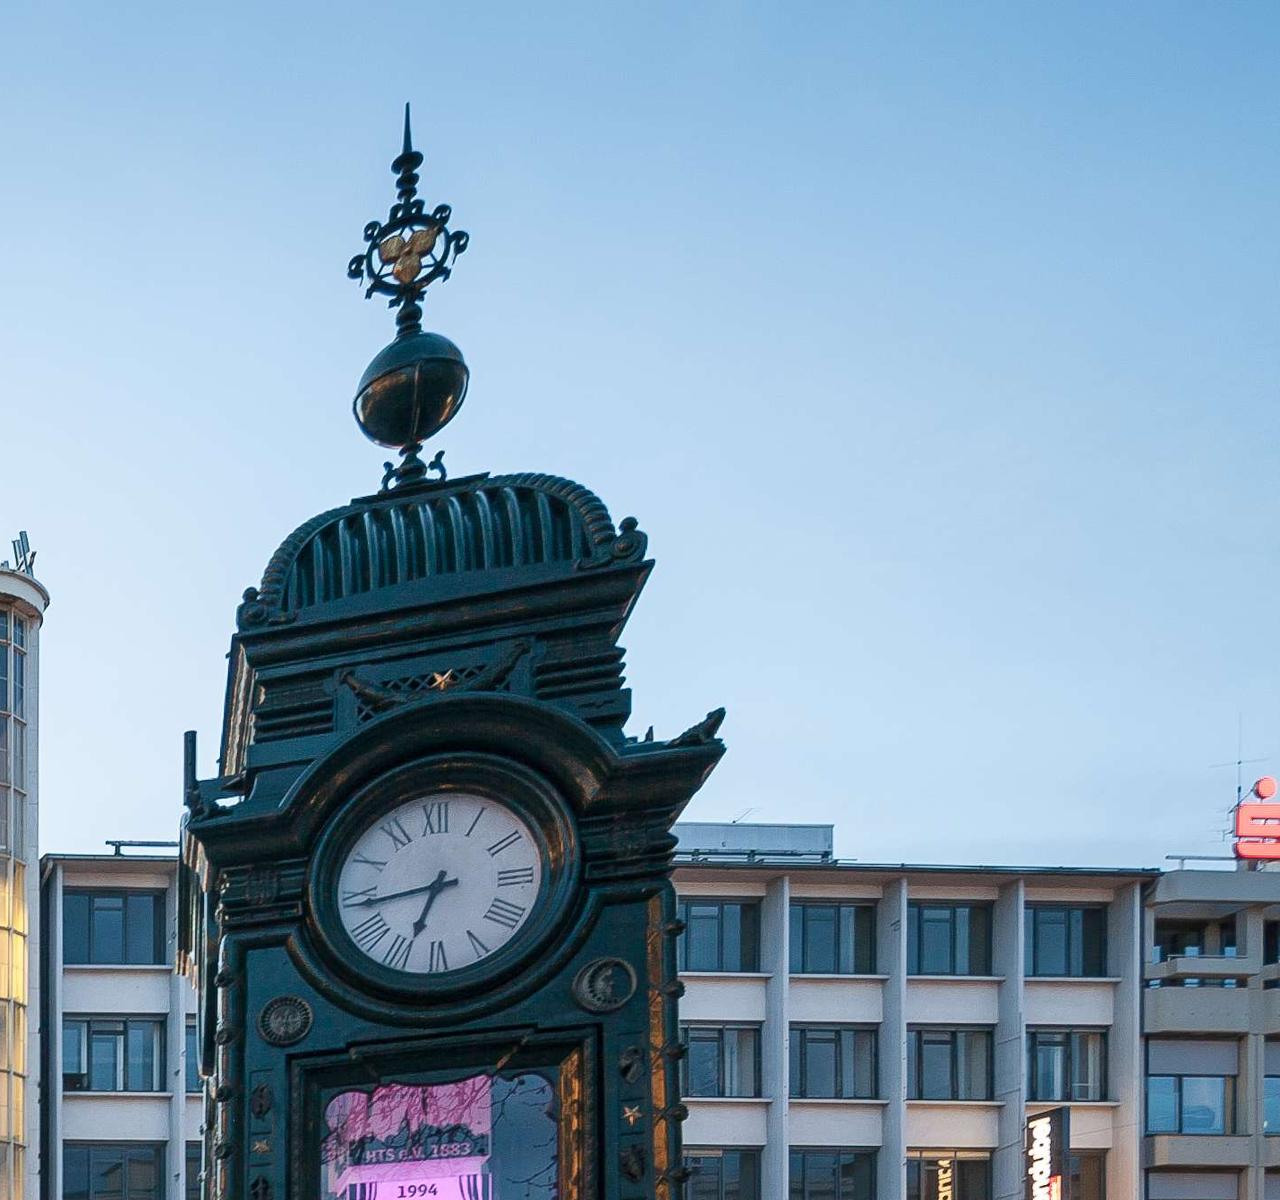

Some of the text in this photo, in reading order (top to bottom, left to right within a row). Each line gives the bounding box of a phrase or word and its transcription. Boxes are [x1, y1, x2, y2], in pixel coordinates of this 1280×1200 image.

[421, 801, 450, 838] XII
[463, 806, 487, 836] I
[379, 816, 414, 853] XI
[487, 829, 523, 858] II
[352, 851, 388, 873] X
[497, 866, 534, 888] III
[397, 1183, 438, 1199] 1994
